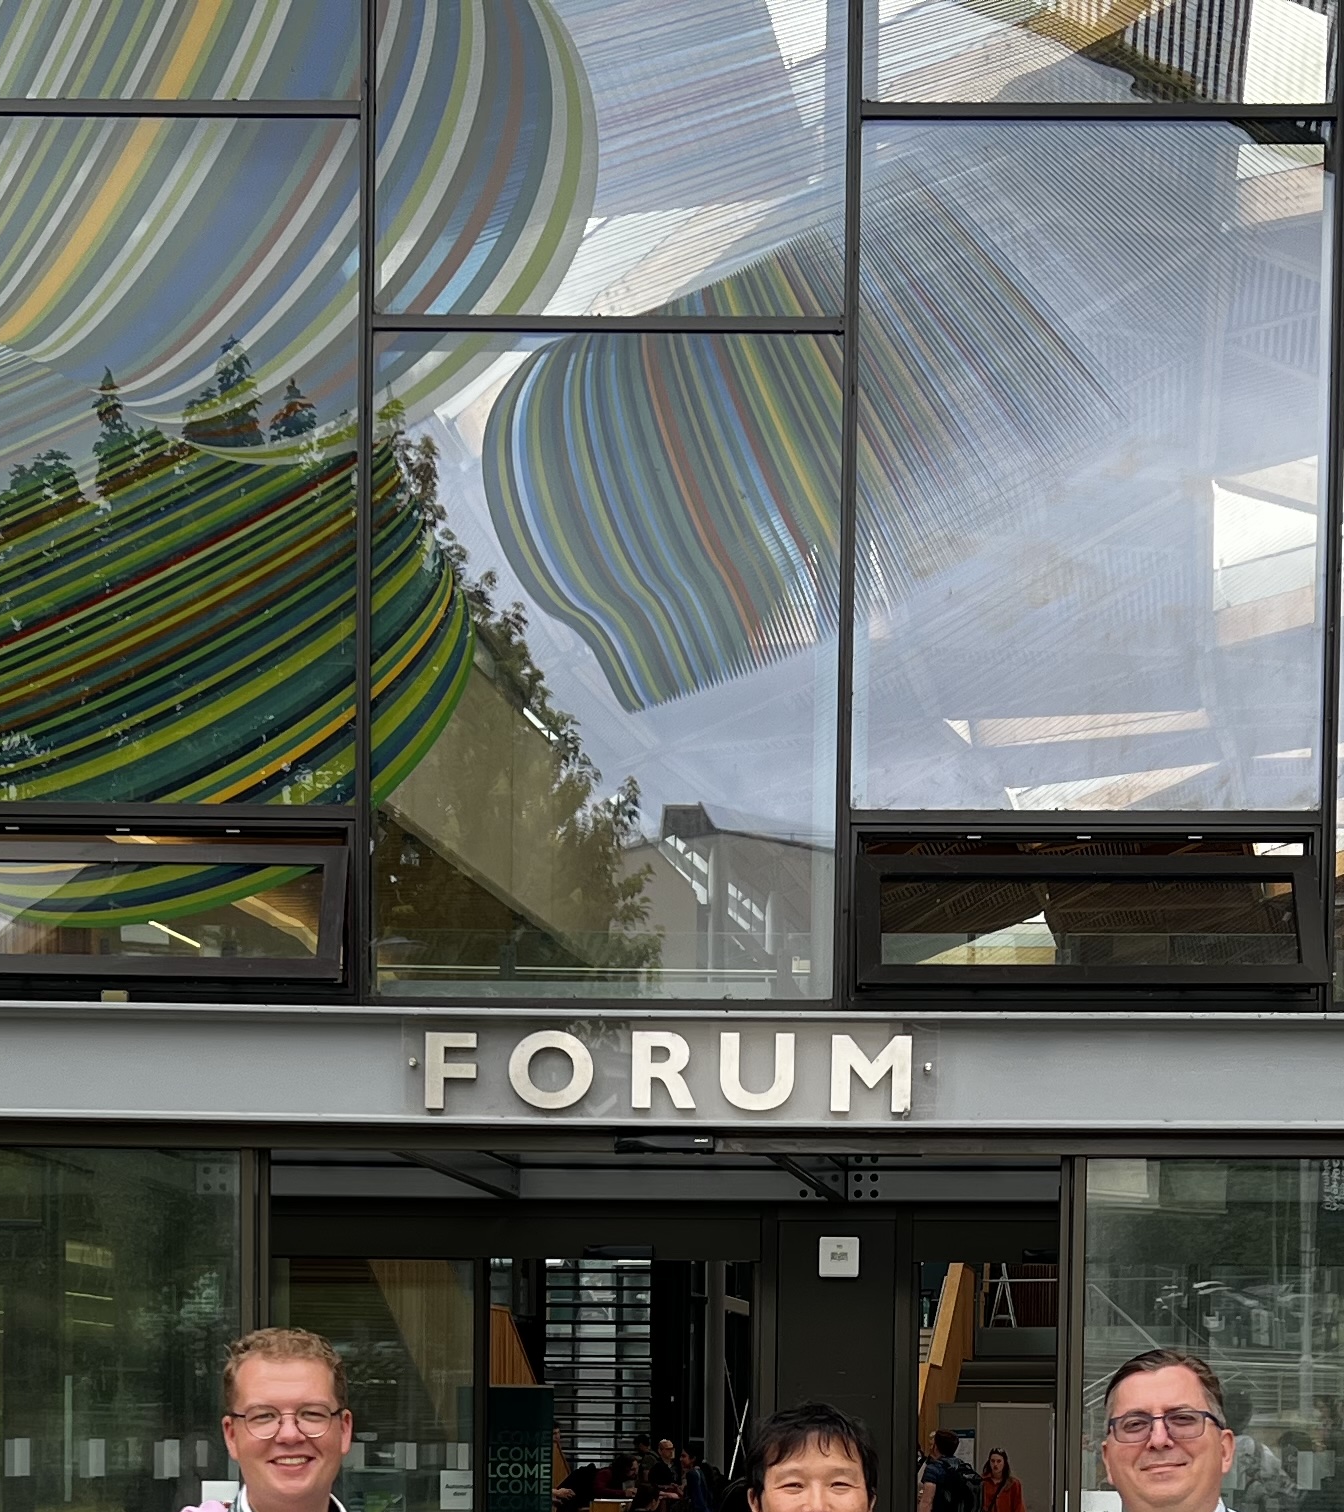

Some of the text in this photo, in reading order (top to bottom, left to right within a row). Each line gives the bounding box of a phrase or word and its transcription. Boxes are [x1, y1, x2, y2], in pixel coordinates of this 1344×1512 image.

[424, 1030, 913, 1113] FORUM
[489, 1446, 551, 1461] LCOME
[488, 1462, 551, 1479] LCOME
[488, 1479, 551, 1495] LCOME
